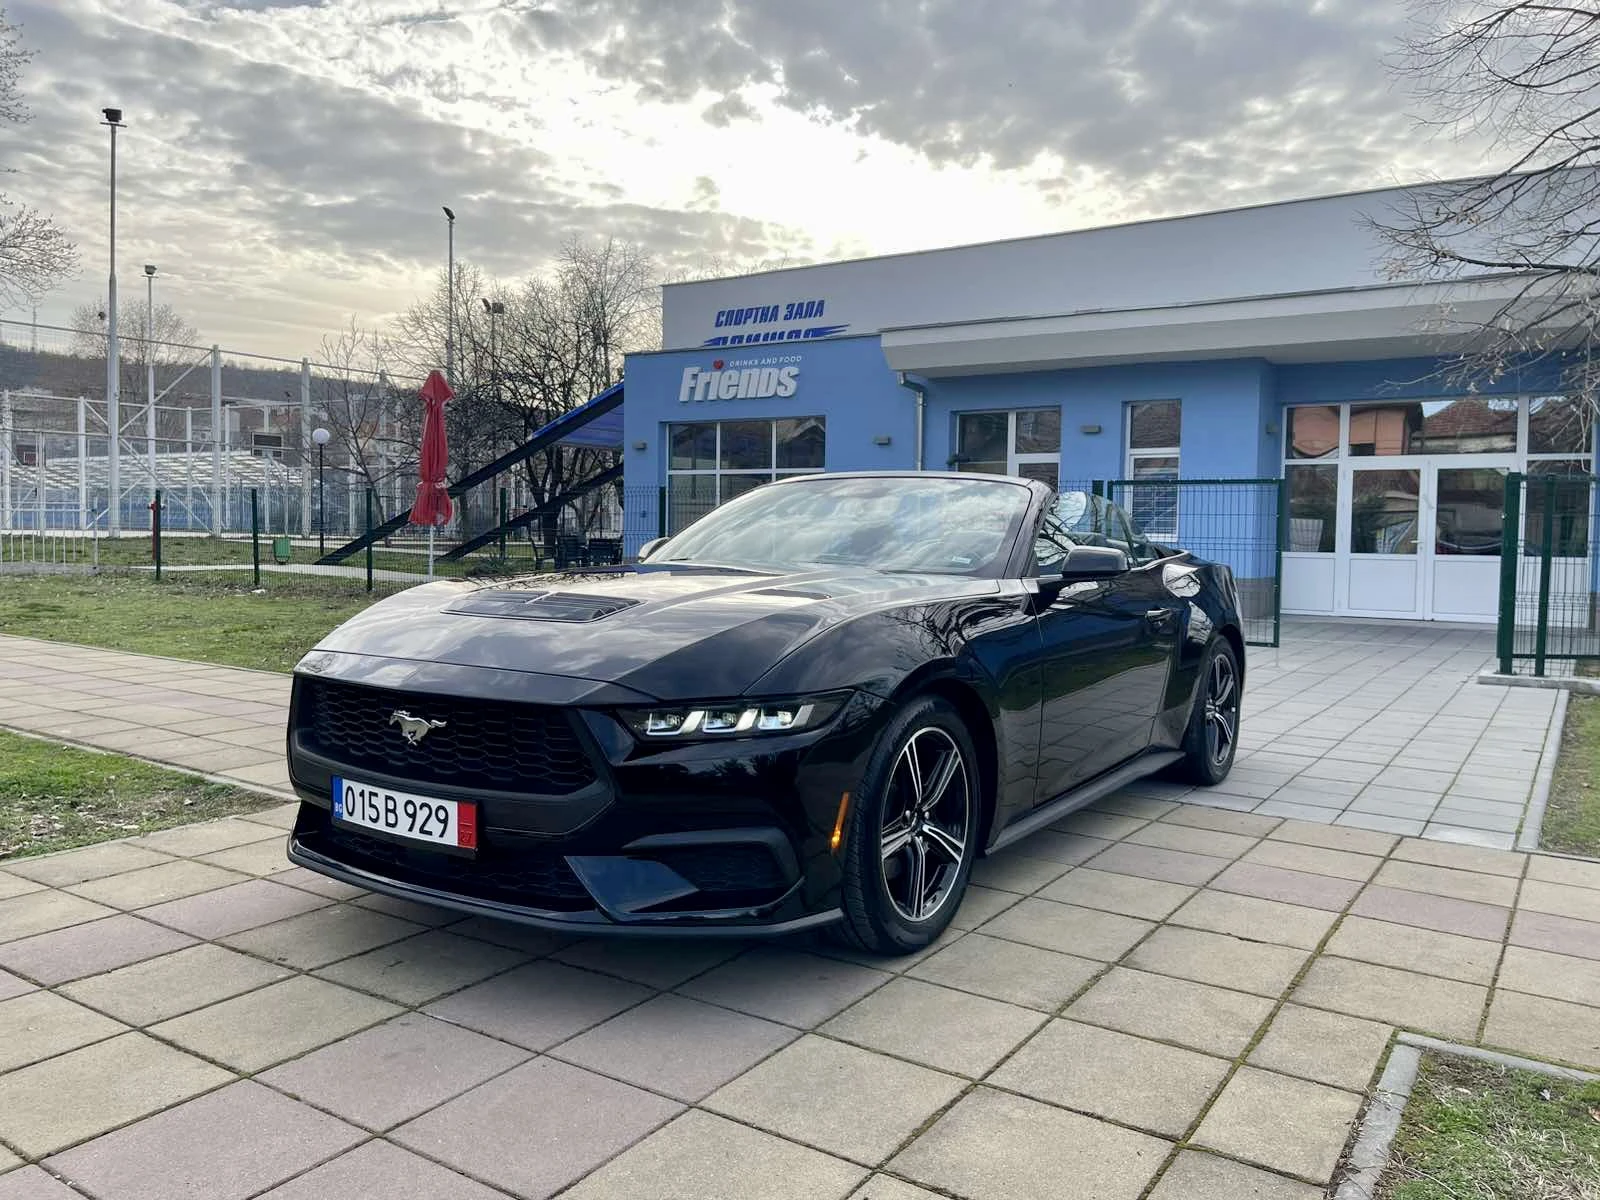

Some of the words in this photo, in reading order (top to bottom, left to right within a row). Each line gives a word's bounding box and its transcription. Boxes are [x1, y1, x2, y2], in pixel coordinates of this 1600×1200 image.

[715, 305, 780, 328] СПОРТНА
[783, 300, 825, 321] ЗАЛА
[760, 357, 777, 365] AND
[779, 355, 802, 363] FOOD
[335, 802, 343, 814] BG
